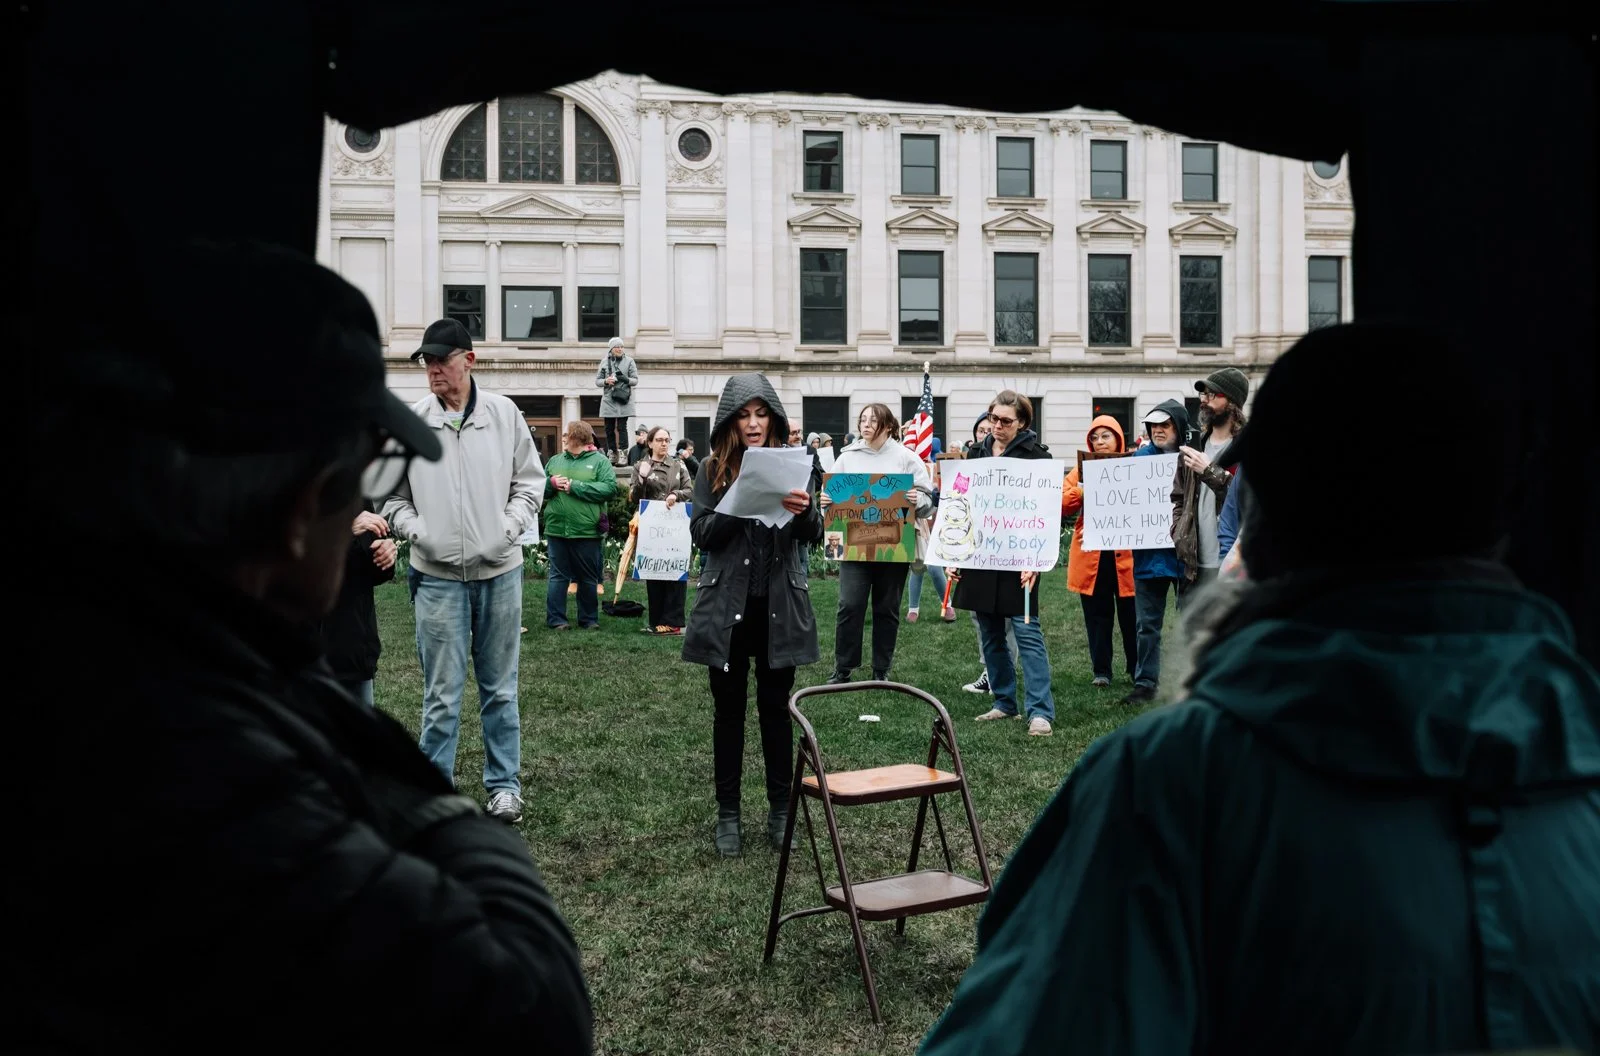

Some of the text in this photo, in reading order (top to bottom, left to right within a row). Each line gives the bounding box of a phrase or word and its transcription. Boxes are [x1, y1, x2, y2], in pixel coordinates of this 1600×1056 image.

[971, 468, 1062, 490] Don't Tread on...
[1099, 463, 1136, 484] ACT
[827, 474, 903, 496] HANDS OFF
[858, 494, 878, 505] OUR
[974, 493, 1038, 513] My Books
[1095, 488, 1140, 507] LOVE
[825, 507, 868, 522] NATIONAL
[1092, 513, 1133, 529] WALK
[983, 515, 1045, 534] My Words
[985, 535, 1047, 554] My Body
[1101, 534, 1144, 547] WITH
[637, 555, 688, 572] NIGHTMARE!
[973, 554, 987, 568] My
[989, 554, 1025, 567] Freedom
[1026, 555, 1034, 566] to
